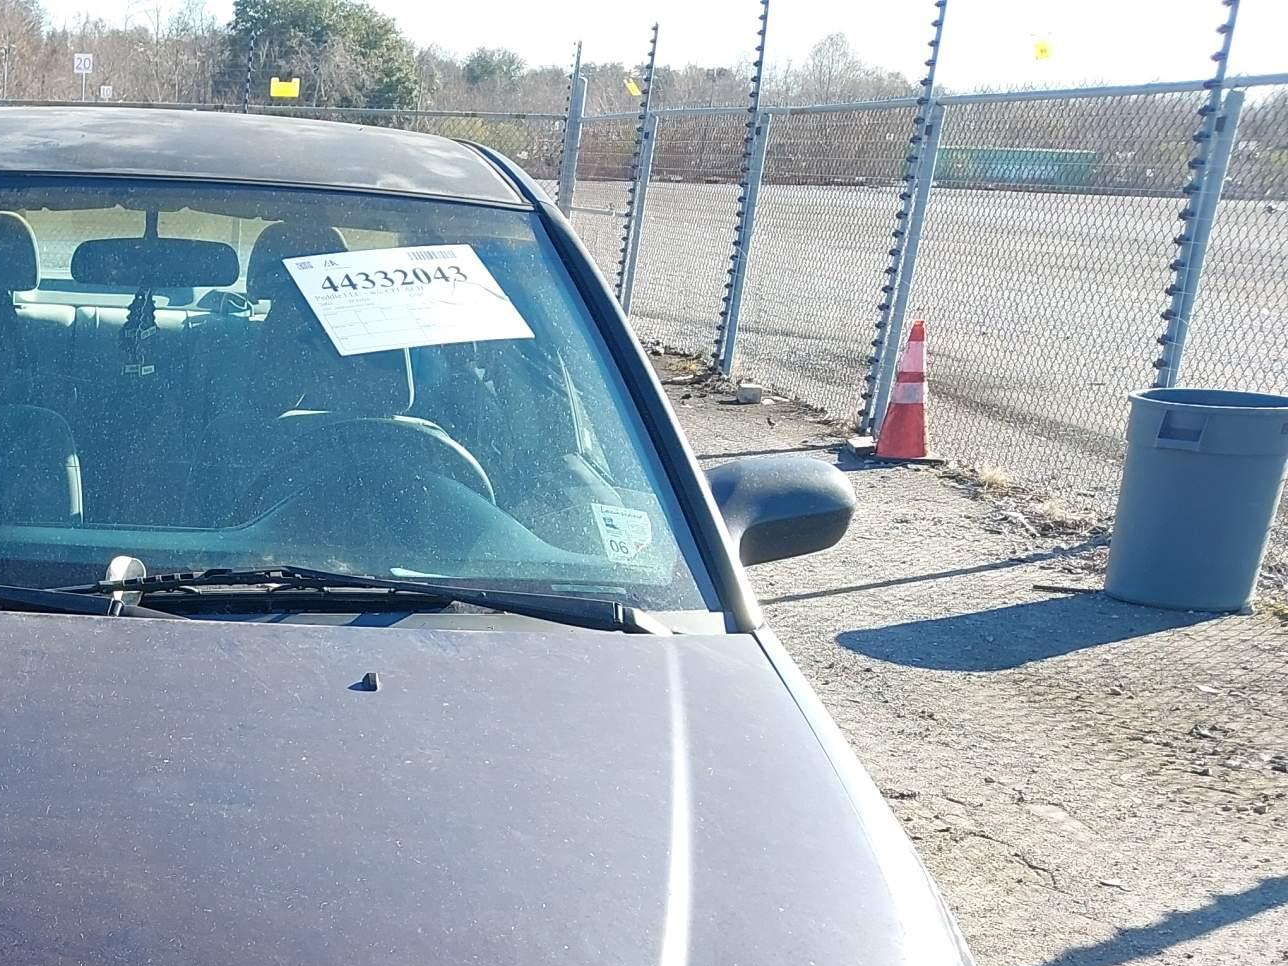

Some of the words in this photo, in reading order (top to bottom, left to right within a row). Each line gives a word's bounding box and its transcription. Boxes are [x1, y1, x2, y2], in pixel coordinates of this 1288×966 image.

[75, 57, 91, 70] 20
[321, 266, 468, 293] 44332043
[609, 539, 629, 555] 06
